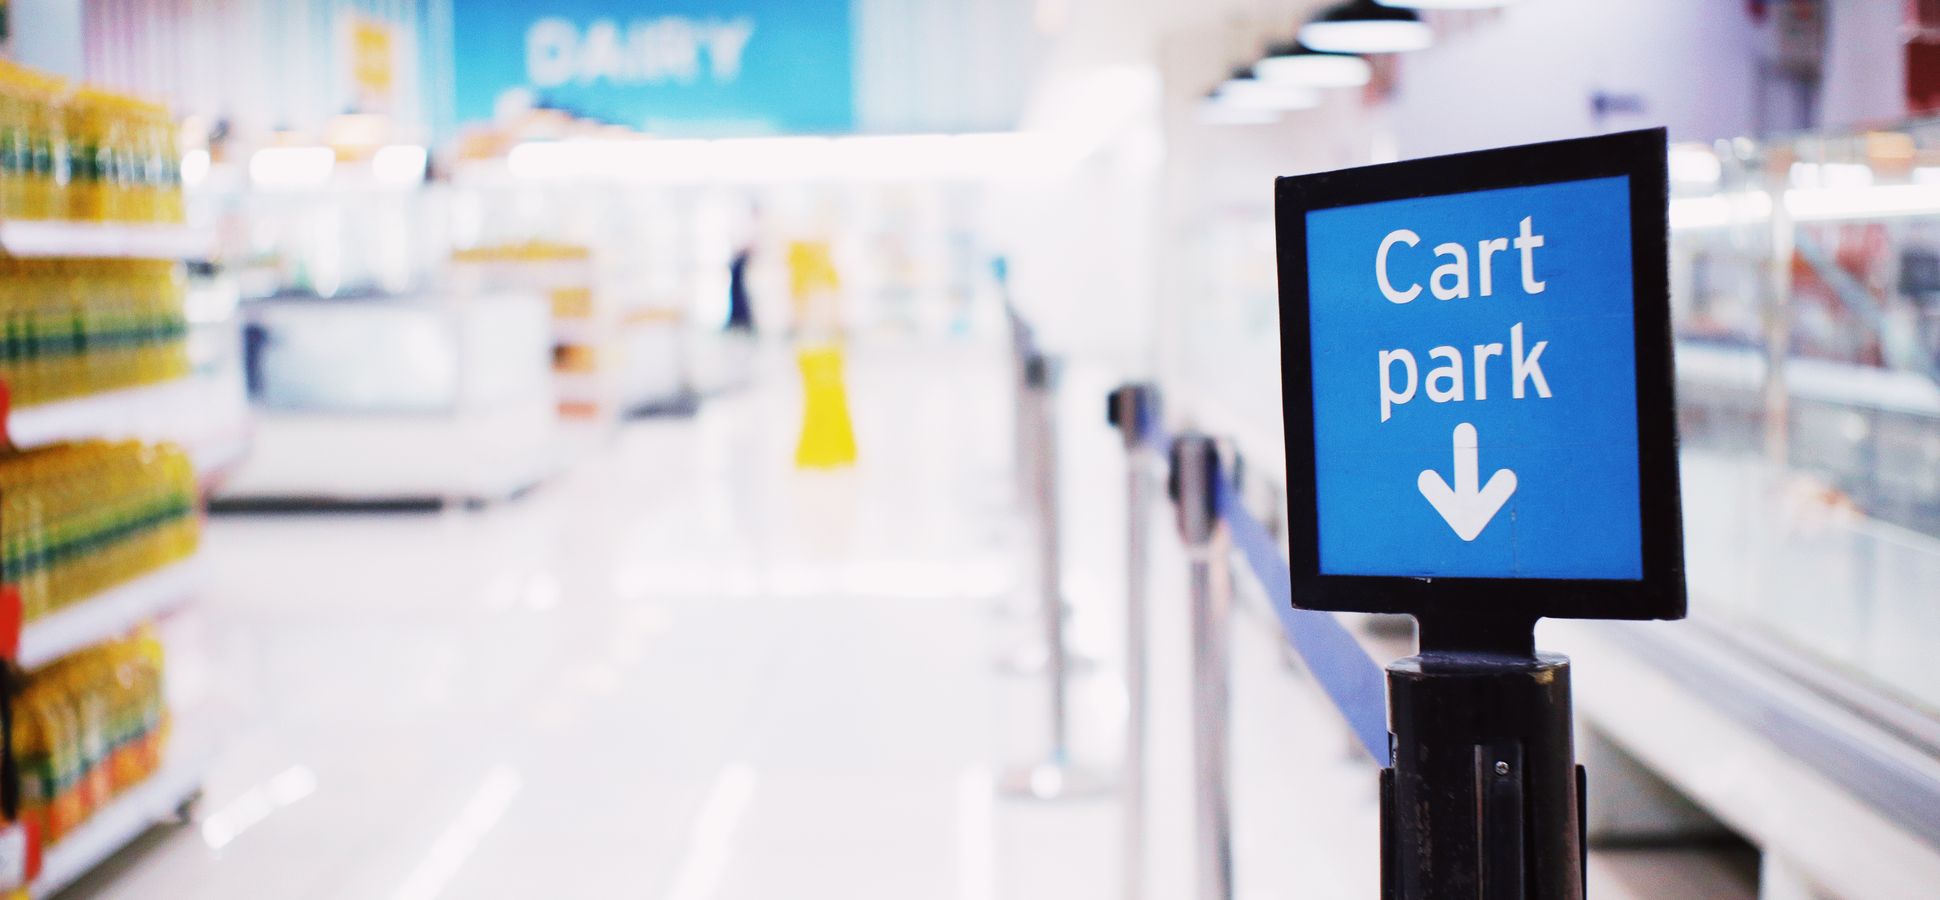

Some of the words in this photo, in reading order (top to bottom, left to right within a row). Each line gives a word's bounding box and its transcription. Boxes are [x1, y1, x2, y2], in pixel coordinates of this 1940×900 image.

[526, 15, 754, 86] DAIRY
[1375, 216, 1546, 304] Cart
[1378, 322, 1553, 423] park
